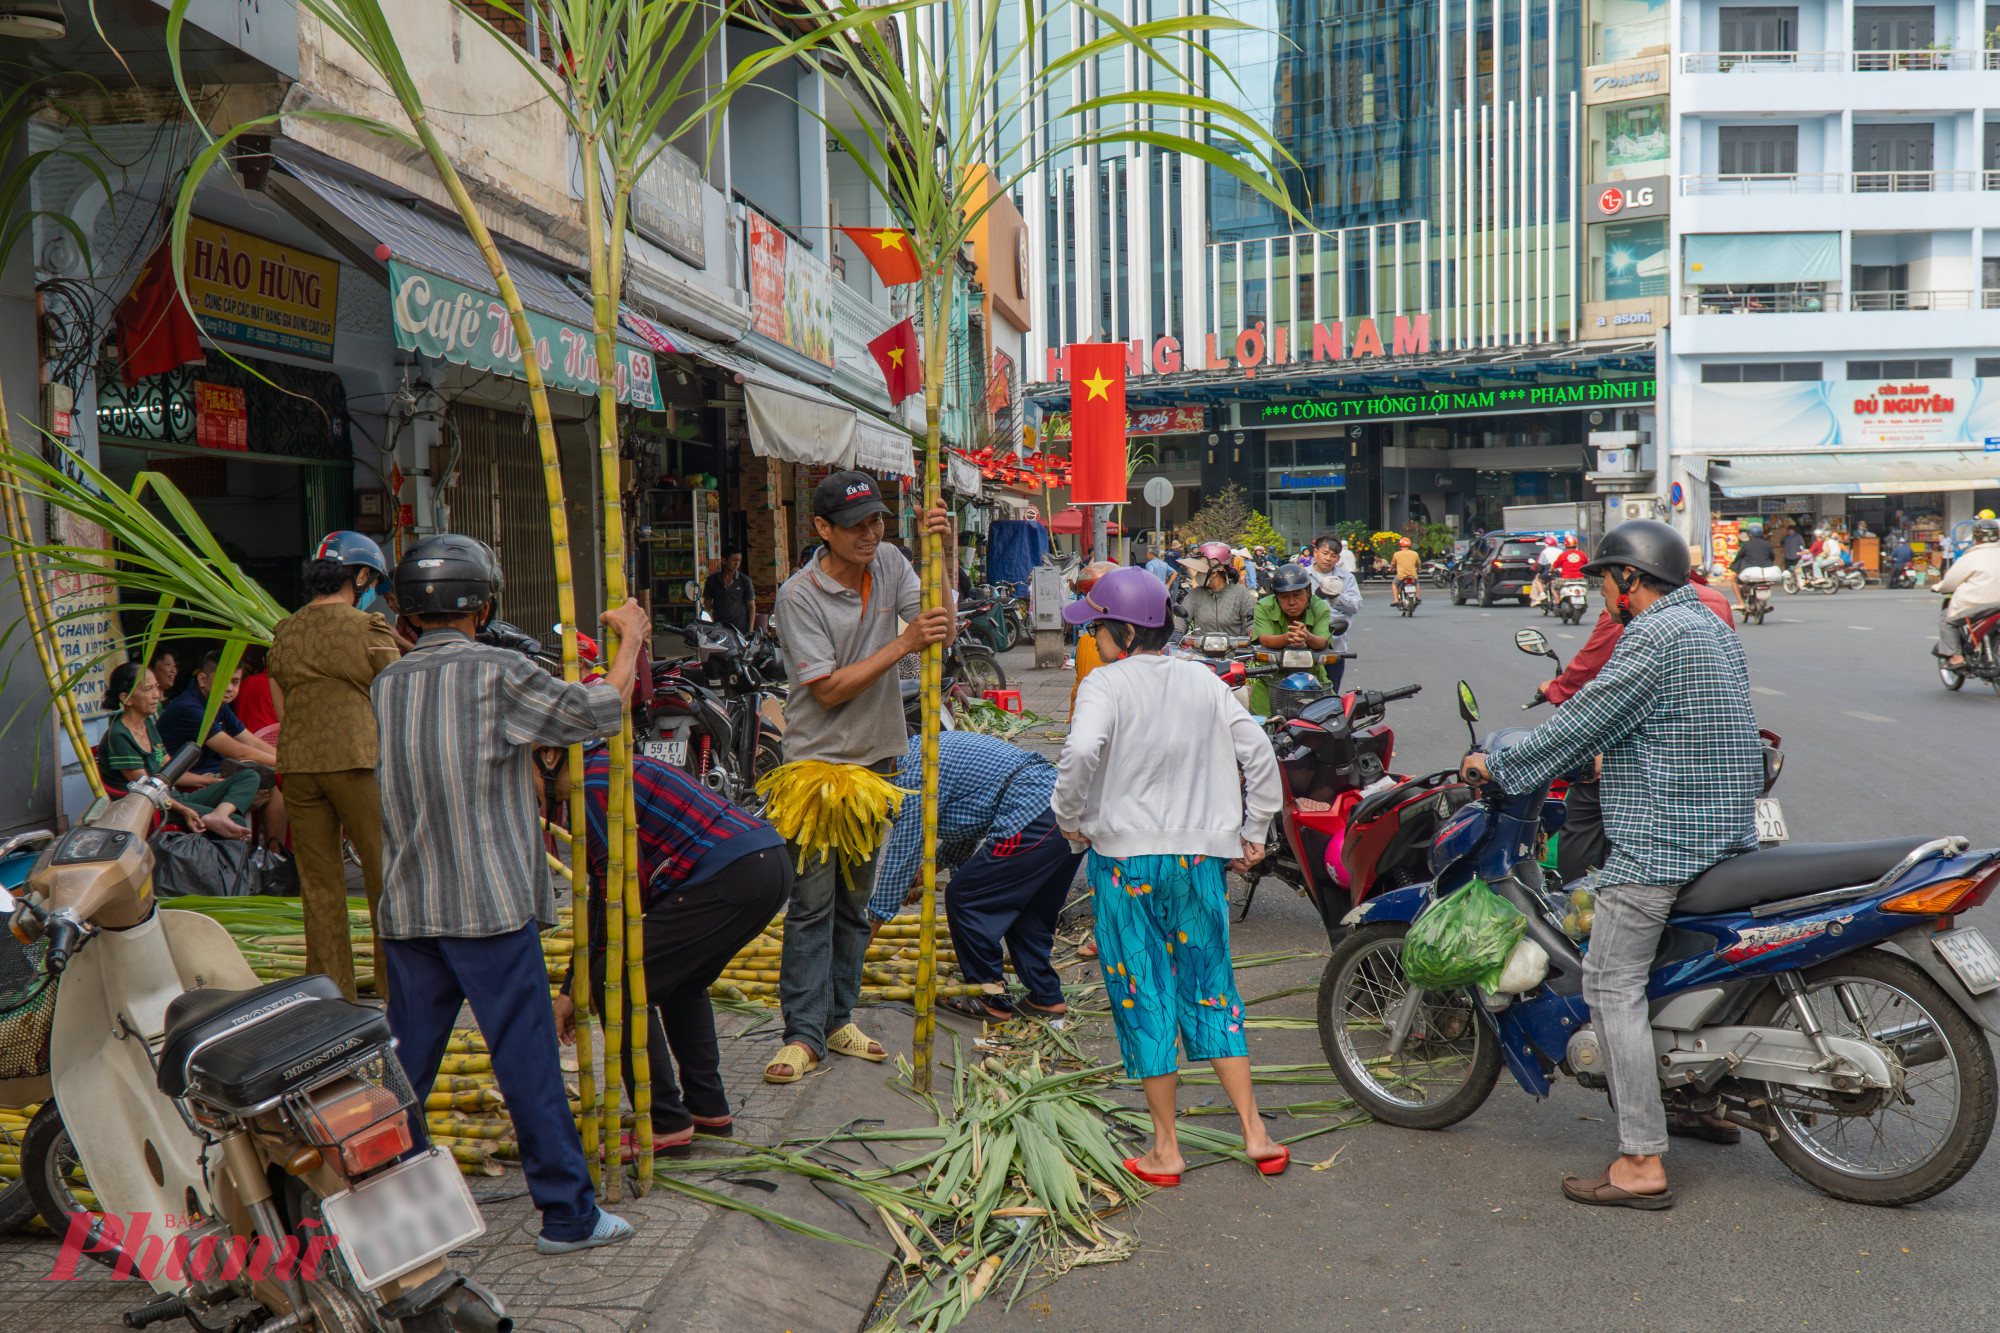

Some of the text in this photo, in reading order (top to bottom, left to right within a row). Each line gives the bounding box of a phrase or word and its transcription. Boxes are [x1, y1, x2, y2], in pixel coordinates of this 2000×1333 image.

[1607, 70, 1659, 88] DAIKIN
[1625, 187, 1654, 208] LG
[192, 231, 322, 310] HÀO HÙNG
[395, 276, 484, 352] Café
[487, 302, 553, 371] Ho
[560, 327, 630, 401] Hùg
[1046, 313, 1430, 383] HNG LỢI NAM
[632, 354, 650, 380] 63
[1291, 400, 1339, 420] CÔNG
[1341, 400, 1364, 416] TY
[1452, 391, 1496, 409] NAM
[1530, 386, 1585, 406] PHẠM
[1588, 379, 1638, 400] ĐÌNH
[1883, 394, 1955, 413] NGUYÊN
[1139, 412, 1170, 428] 2026
[1280, 473, 1346, 489] Panasonic
[57, 619, 95, 639] CHANH
[60, 639, 82, 657] TRÀ
[650, 742, 679, 754] 59-K1
[282, 1037, 364, 1081] HONDA
